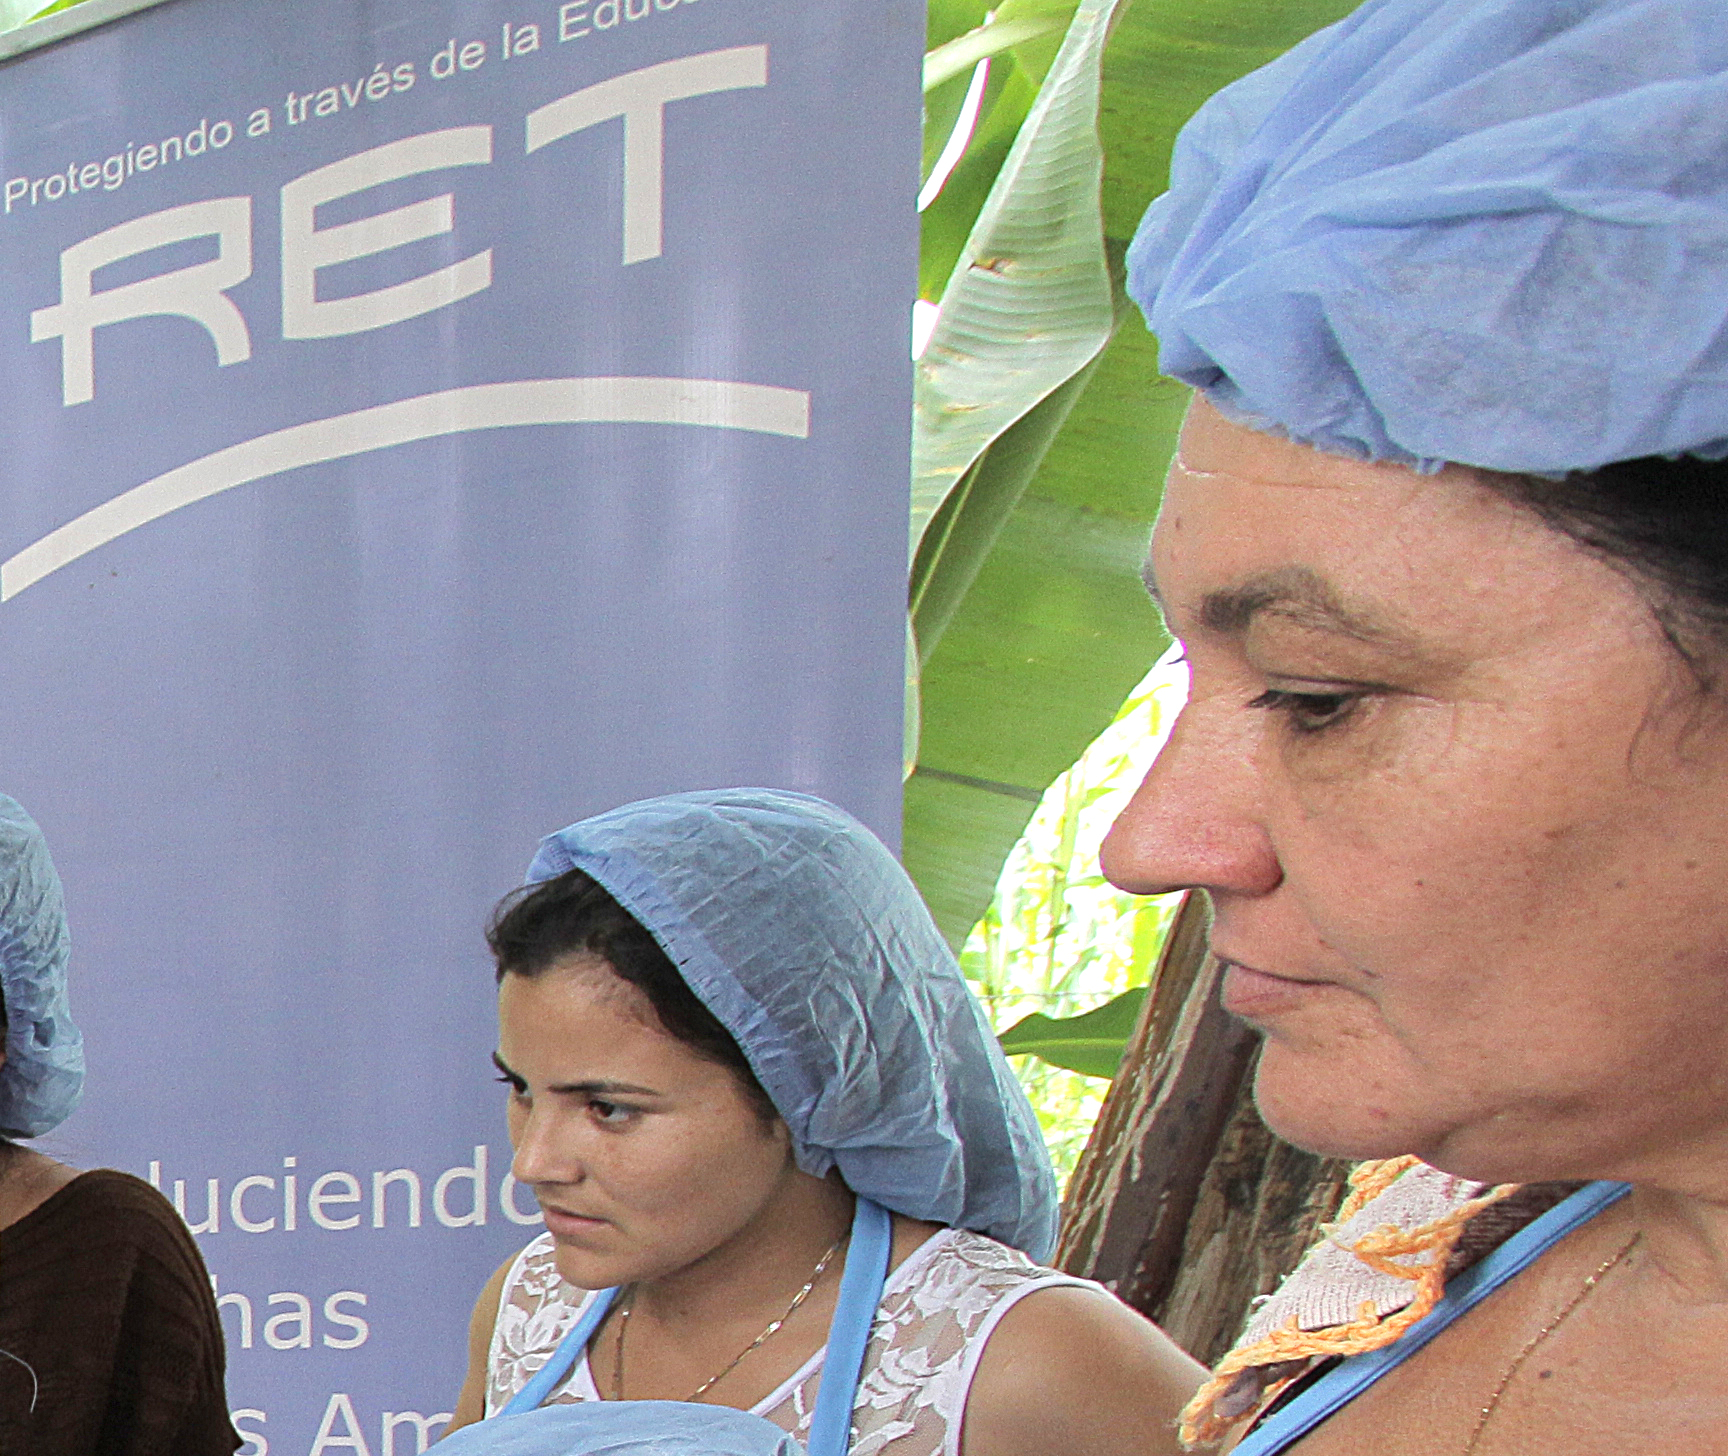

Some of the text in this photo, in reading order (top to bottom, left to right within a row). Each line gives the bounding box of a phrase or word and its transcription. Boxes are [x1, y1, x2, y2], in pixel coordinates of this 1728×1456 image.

[3, 0, 701, 214] Protegiendo a través de la Edu
[30, 44, 768, 406] RET
[149, 1145, 545, 1235] uciendo
